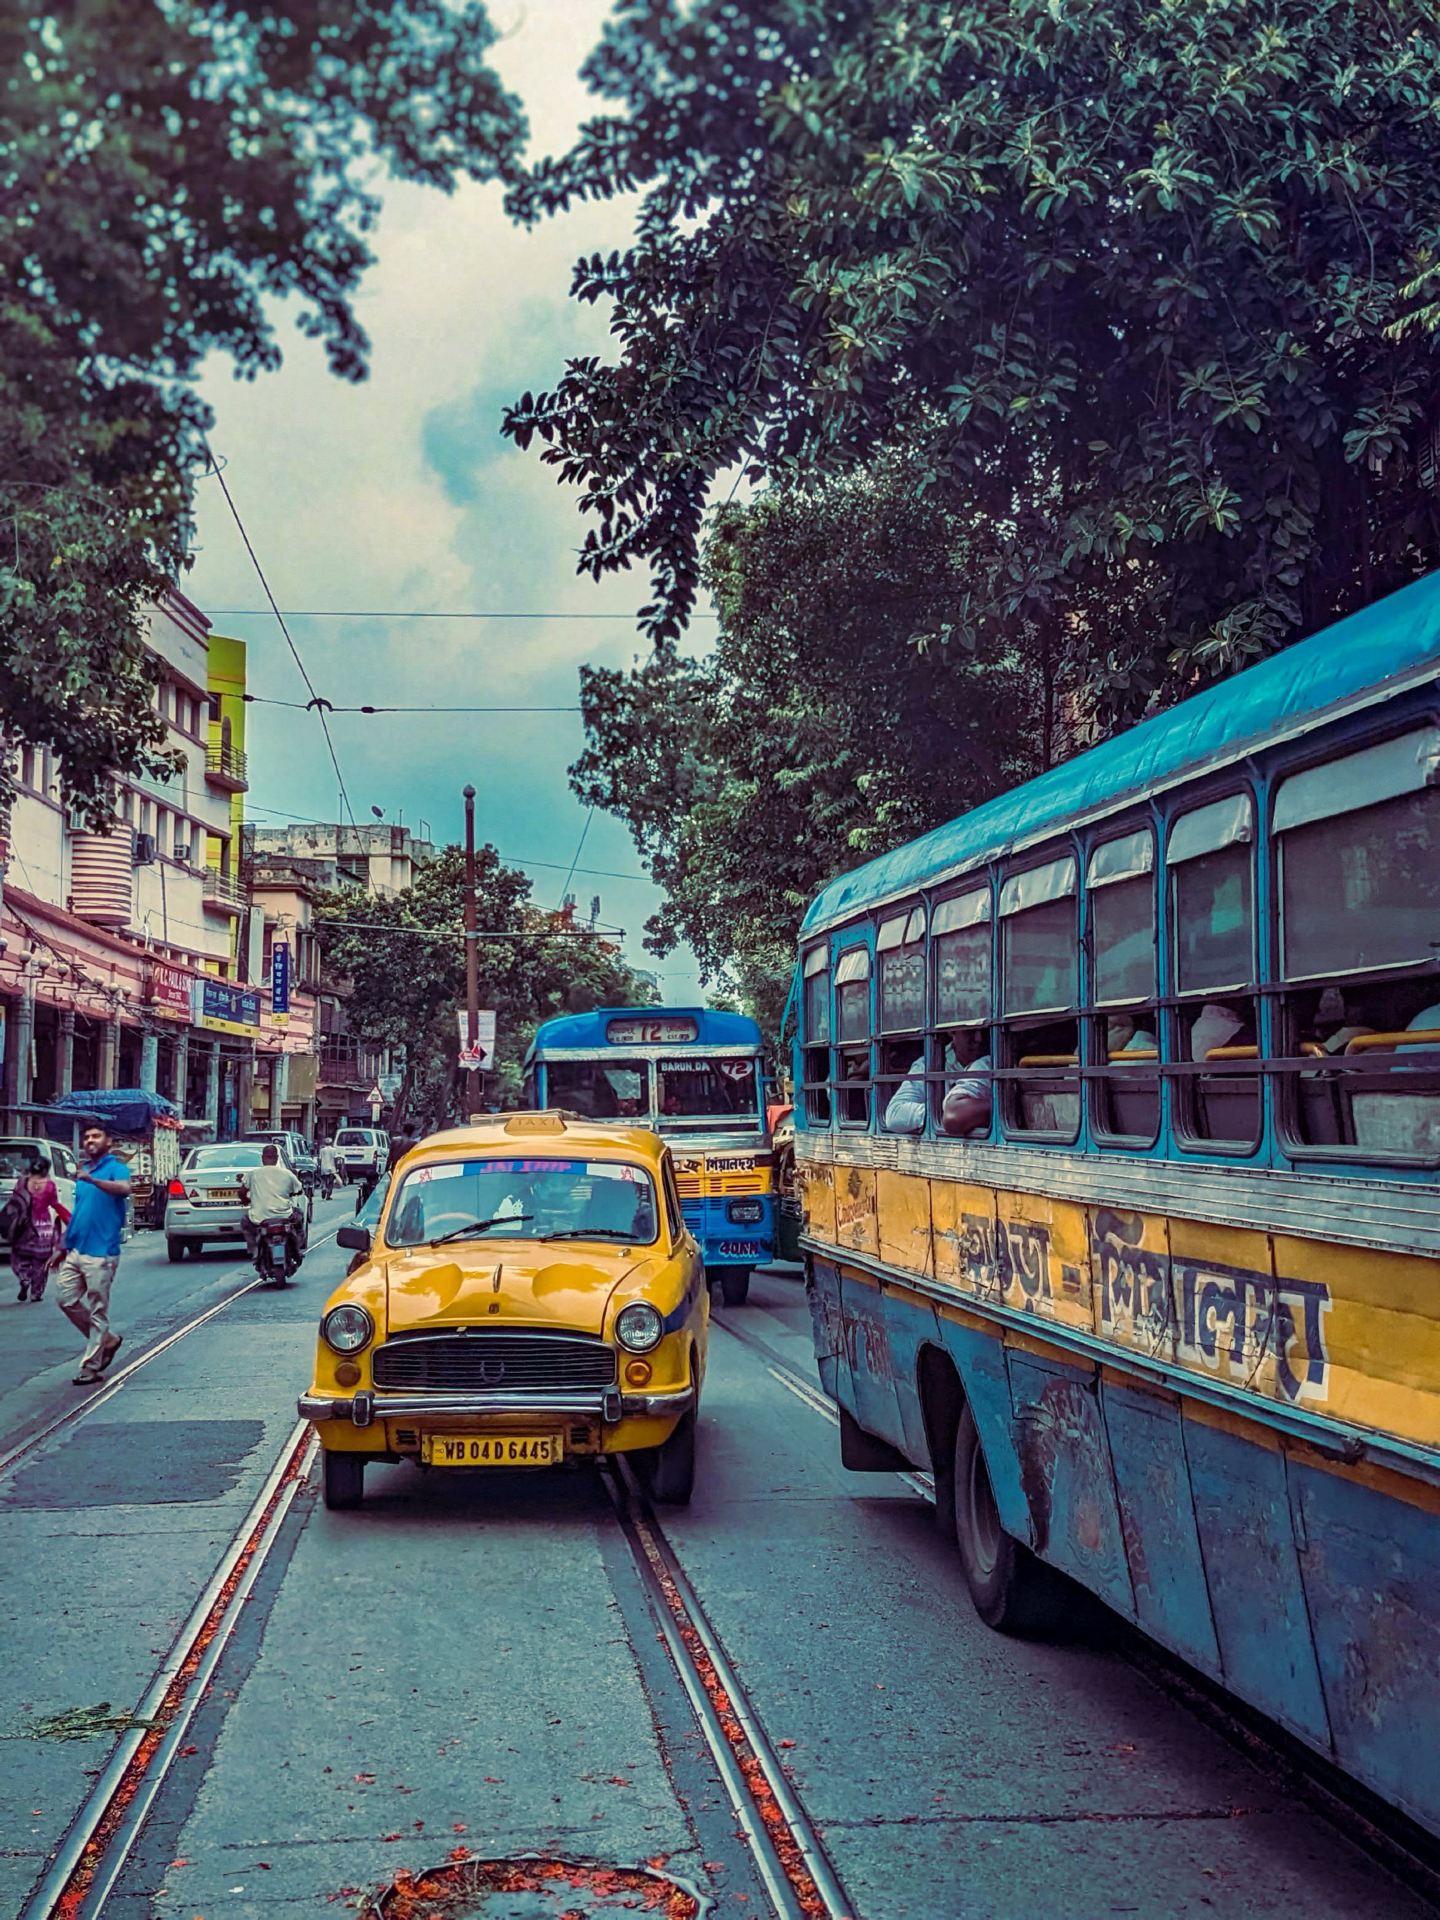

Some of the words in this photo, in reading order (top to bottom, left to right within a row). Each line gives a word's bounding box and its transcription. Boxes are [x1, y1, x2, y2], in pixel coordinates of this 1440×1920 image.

[639, 1022, 662, 1041] 72
[722, 1061, 748, 1075] 72
[517, 1118, 556, 1126] TAXI
[444, 1441, 465, 1460] WB
[470, 1441, 490, 1460] 04
[494, 1441, 504, 1460] D
[508, 1440, 549, 1460] 6445
